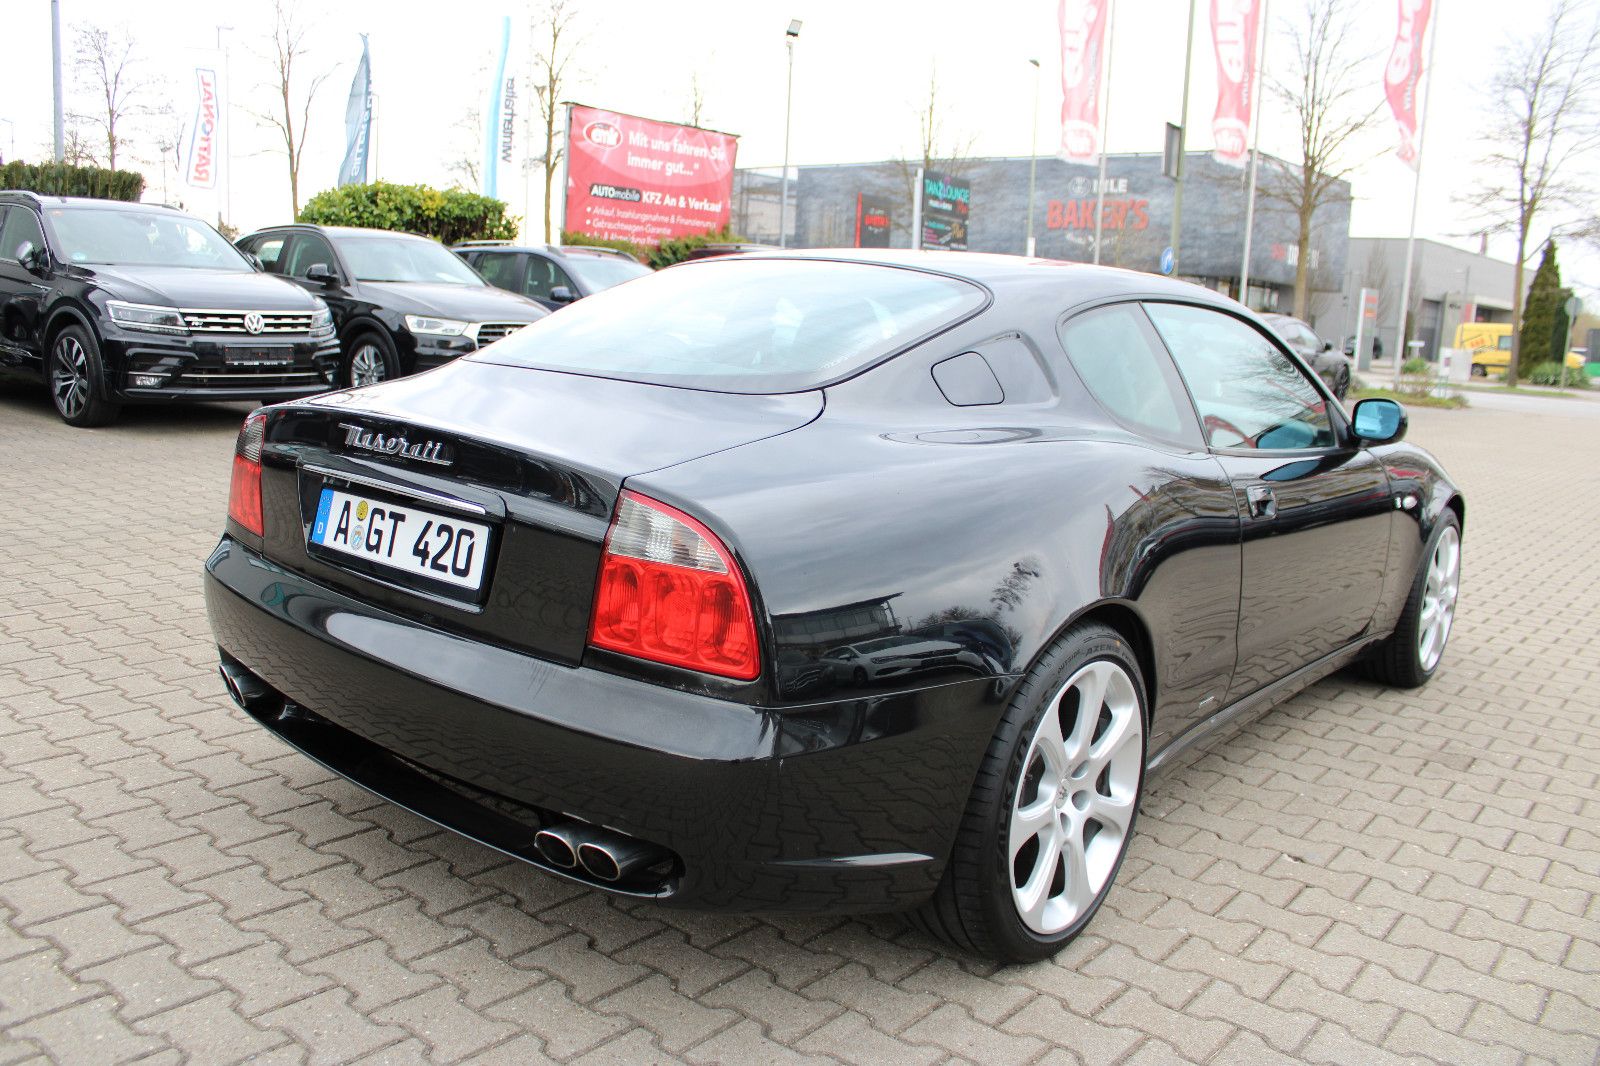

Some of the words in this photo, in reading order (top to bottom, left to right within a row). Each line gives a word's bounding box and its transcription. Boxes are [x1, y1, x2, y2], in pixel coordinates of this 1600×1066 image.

[628, 131, 648, 148] Mit
[651, 138, 670, 152] uns
[672, 138, 707, 159] fahren
[627, 152, 663, 170] immer
[642, 190, 662, 205] KFZ
[663, 193, 677, 207] An
[678, 196, 686, 208] &
[1046, 198, 1151, 231] BAKER'S
[338, 422, 453, 466] Maserati
[317, 521, 324, 534] D
[333, 500, 352, 545] A
[365, 507, 407, 558] GT
[412, 520, 475, 578] 420
